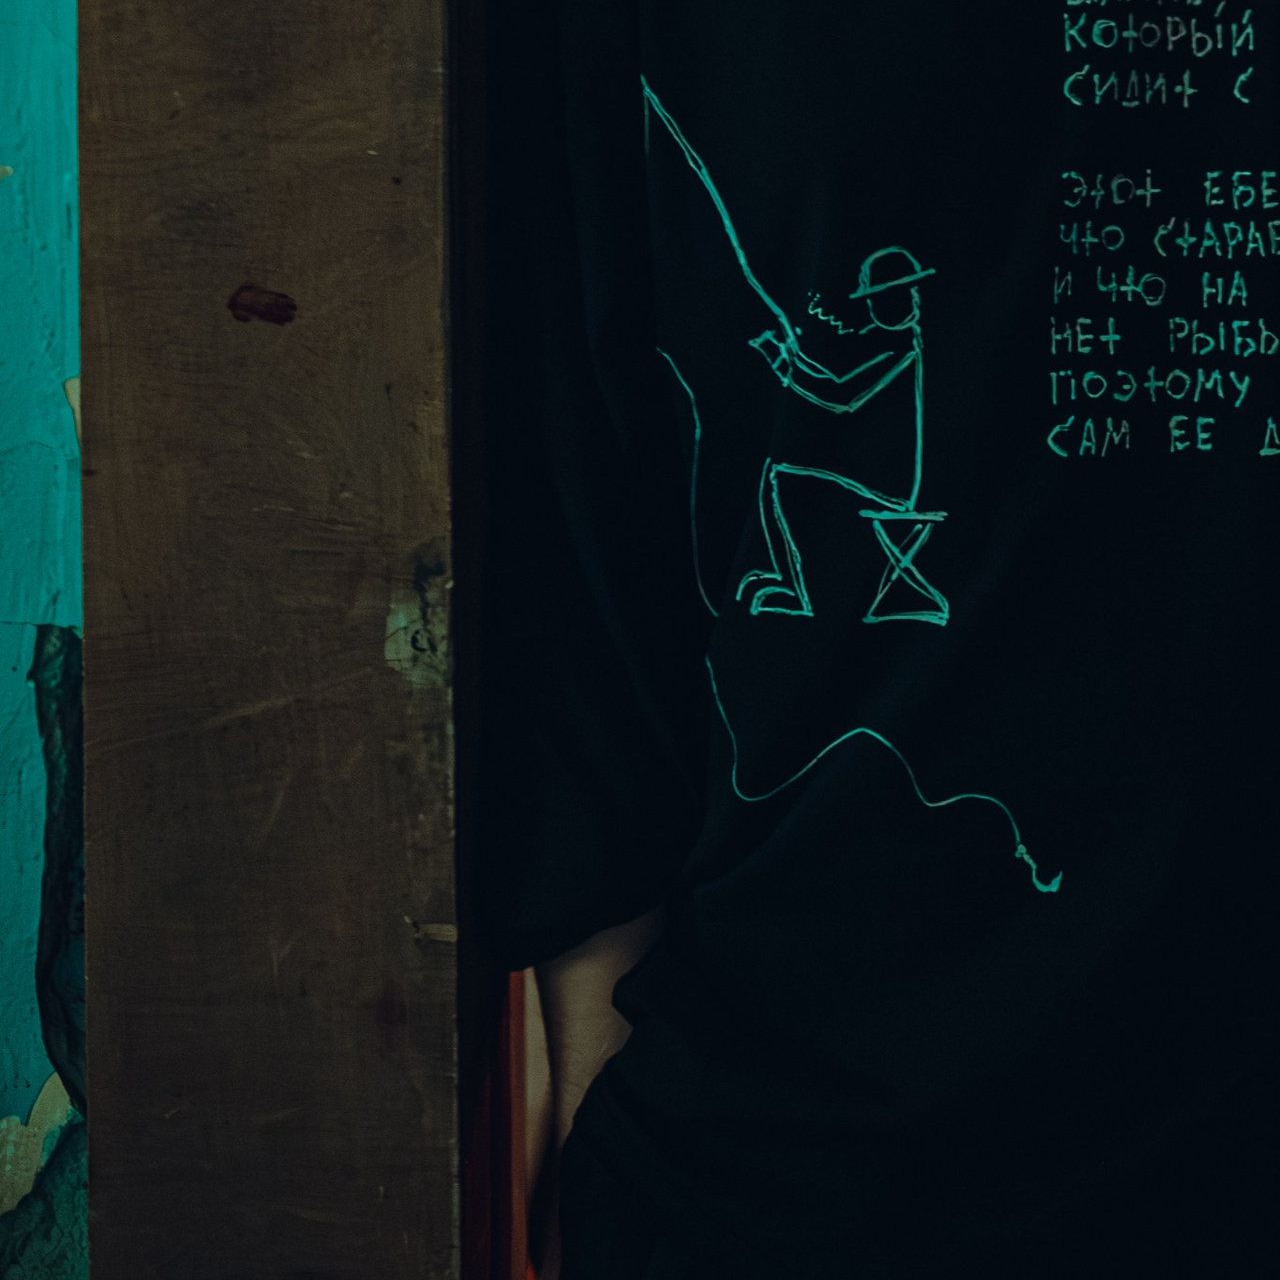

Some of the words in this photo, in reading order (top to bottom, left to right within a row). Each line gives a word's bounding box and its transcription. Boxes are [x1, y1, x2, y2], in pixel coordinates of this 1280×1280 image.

[1062, 6, 1255, 58] КОТОРЫЙ
[1062, 63, 1199, 109] СИДИТ
[1232, 65, 1255, 105] С
[1060, 168, 1163, 210] ЭТОТ
[1058, 220, 1126, 257] ЧТО
[1053, 265, 1073, 305] И
[1096, 264, 1167, 307] ЧТО
[1201, 269, 1249, 309] НА
[1050, 316, 1122, 356] НЕТ
[1049, 365, 1251, 409] ПОЭТОМУ
[1046, 414, 1131, 459] САМ
[1168, 414, 1216, 454] ЕЕ
